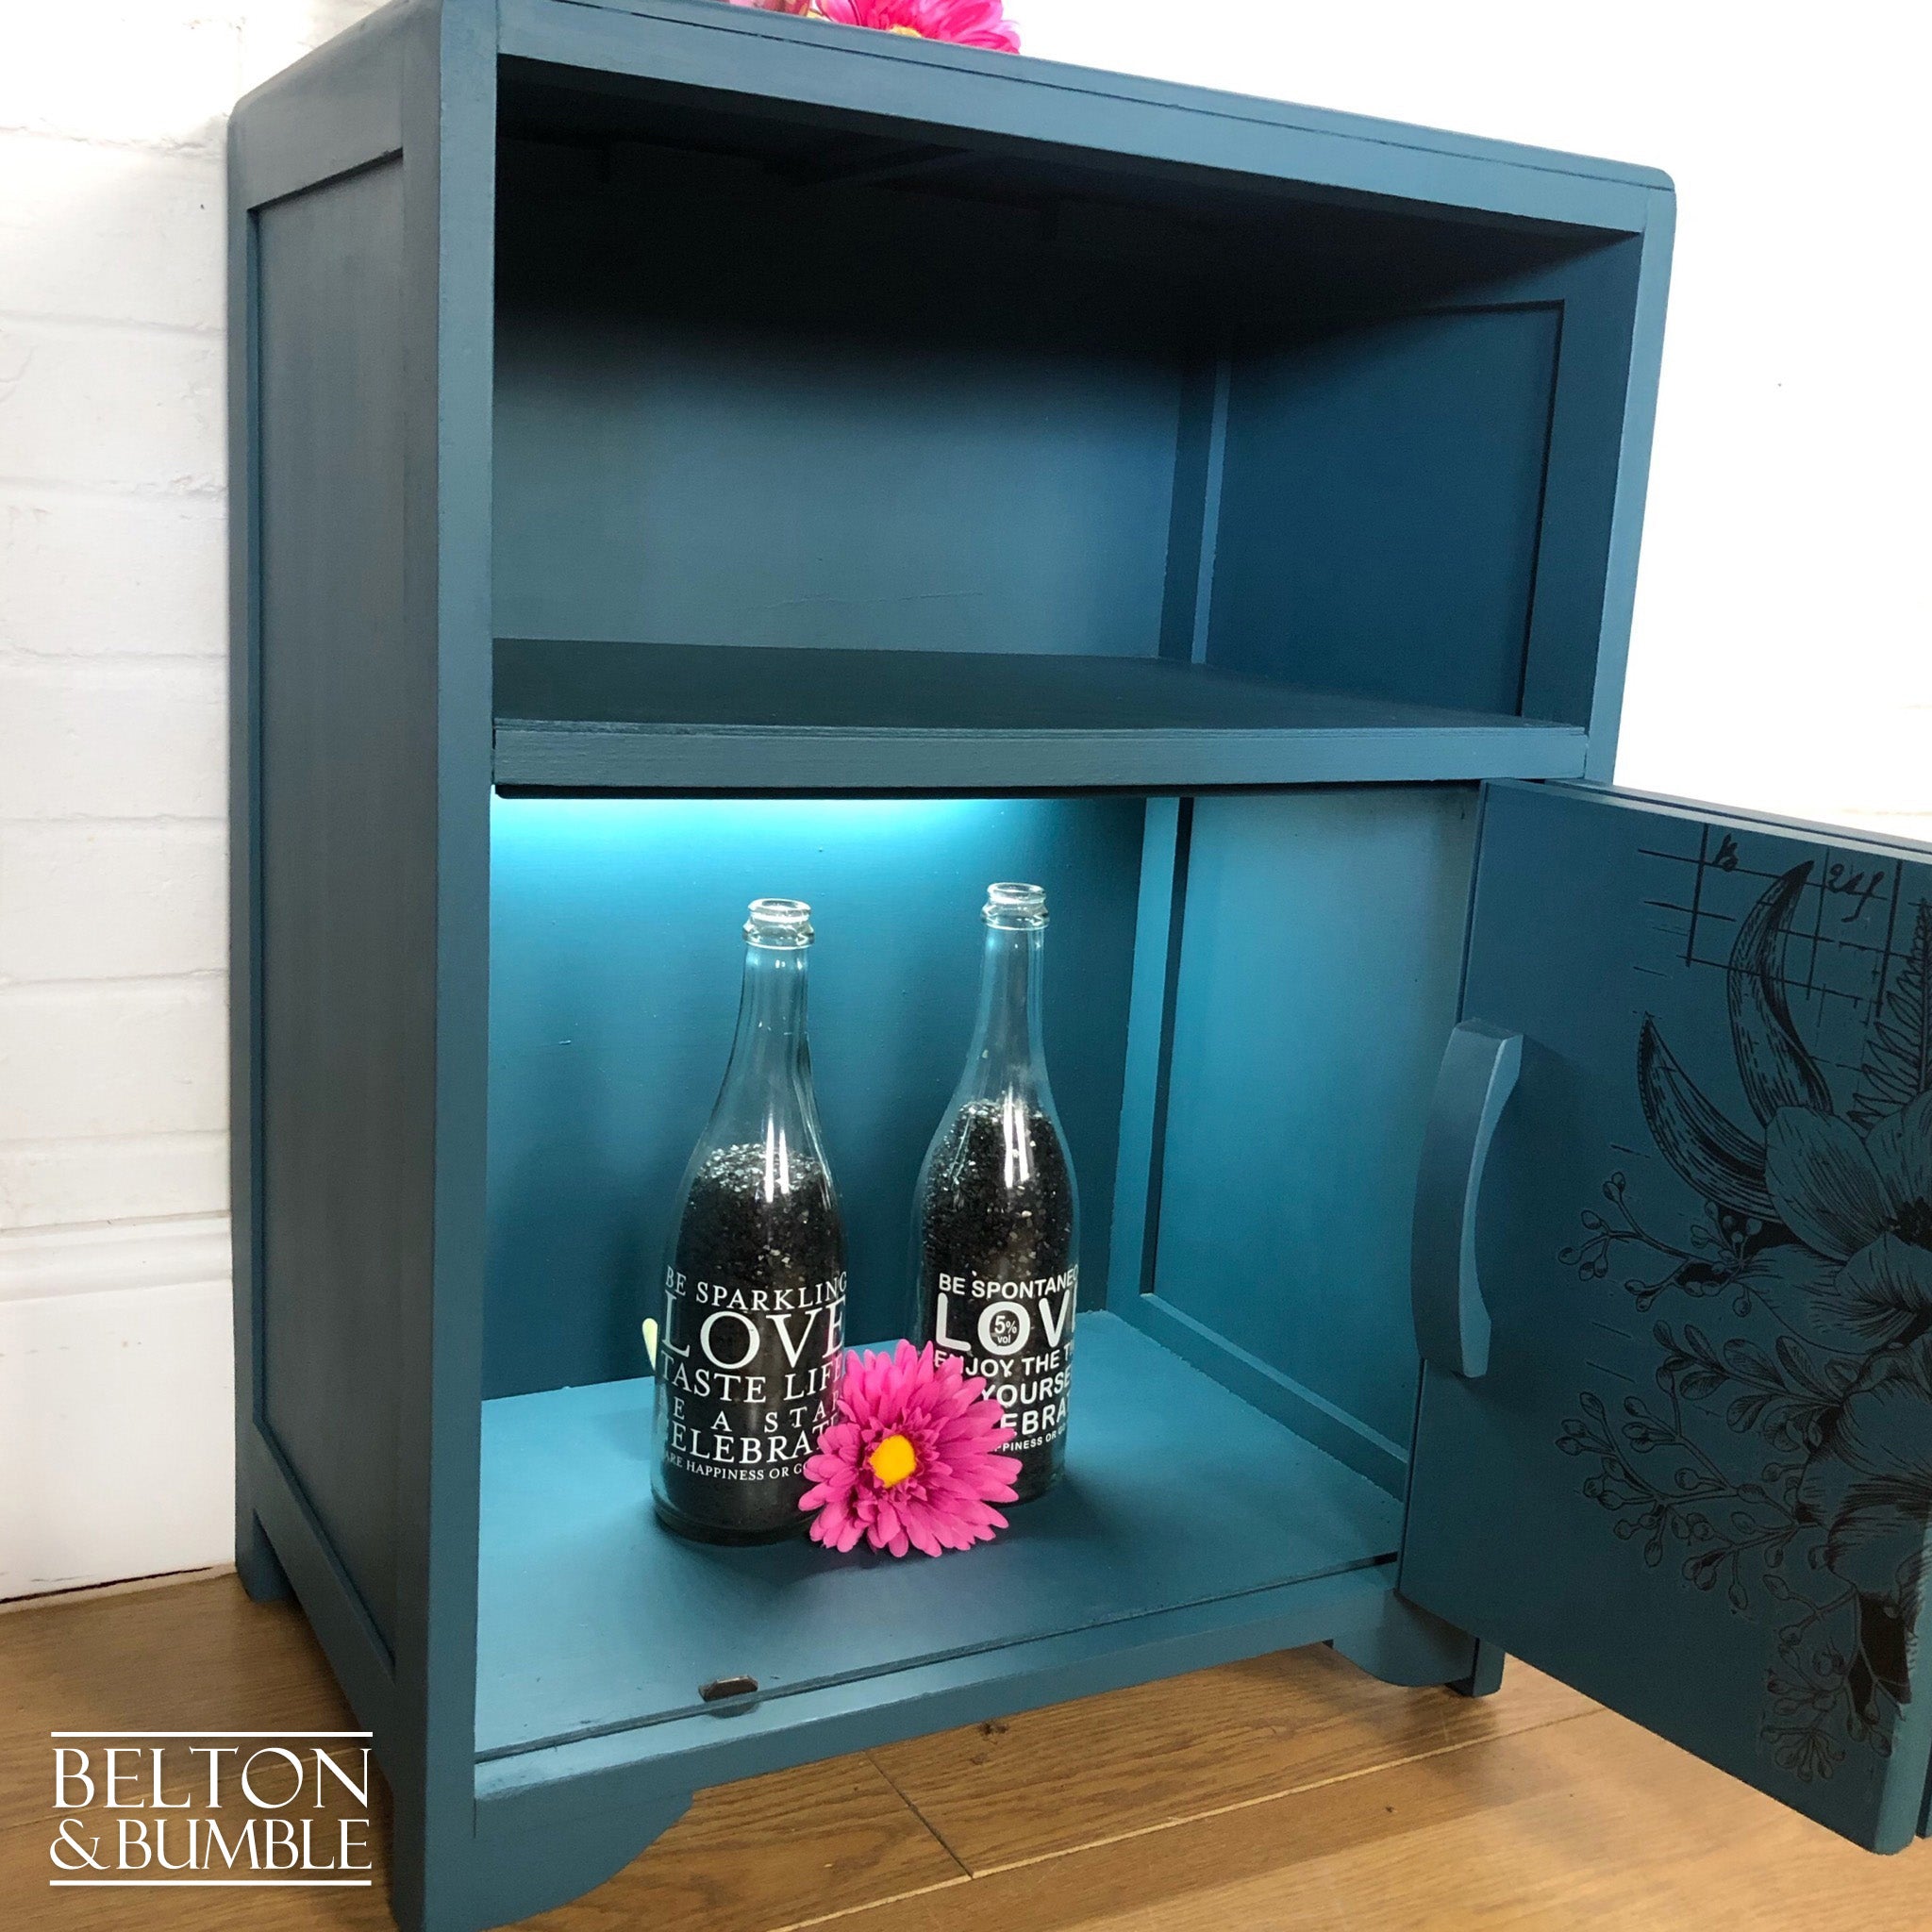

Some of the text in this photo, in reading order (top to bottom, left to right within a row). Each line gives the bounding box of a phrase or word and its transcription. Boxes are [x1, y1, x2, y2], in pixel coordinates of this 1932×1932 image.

[665, 1265, 847, 1311] BE SPARKLING
[939, 1273, 966, 1295] BE
[662, 1290, 847, 1370] LOVE
[936, 1281, 1078, 1357] LOV
[994, 1315, 1018, 1335] 5%
[997, 1334, 1012, 1345] vol
[934, 1349, 1015, 1378] EJOY
[1022, 1349, 1060, 1376] THE
[661, 1349, 843, 1404] TASTE LIFE
[710, 1410, 733, 1433] A
[1045, 1430, 1057, 1442] OR
[686, 1459, 765, 1481] HAPPINESS
[769, 1467, 790, 1480] OR
